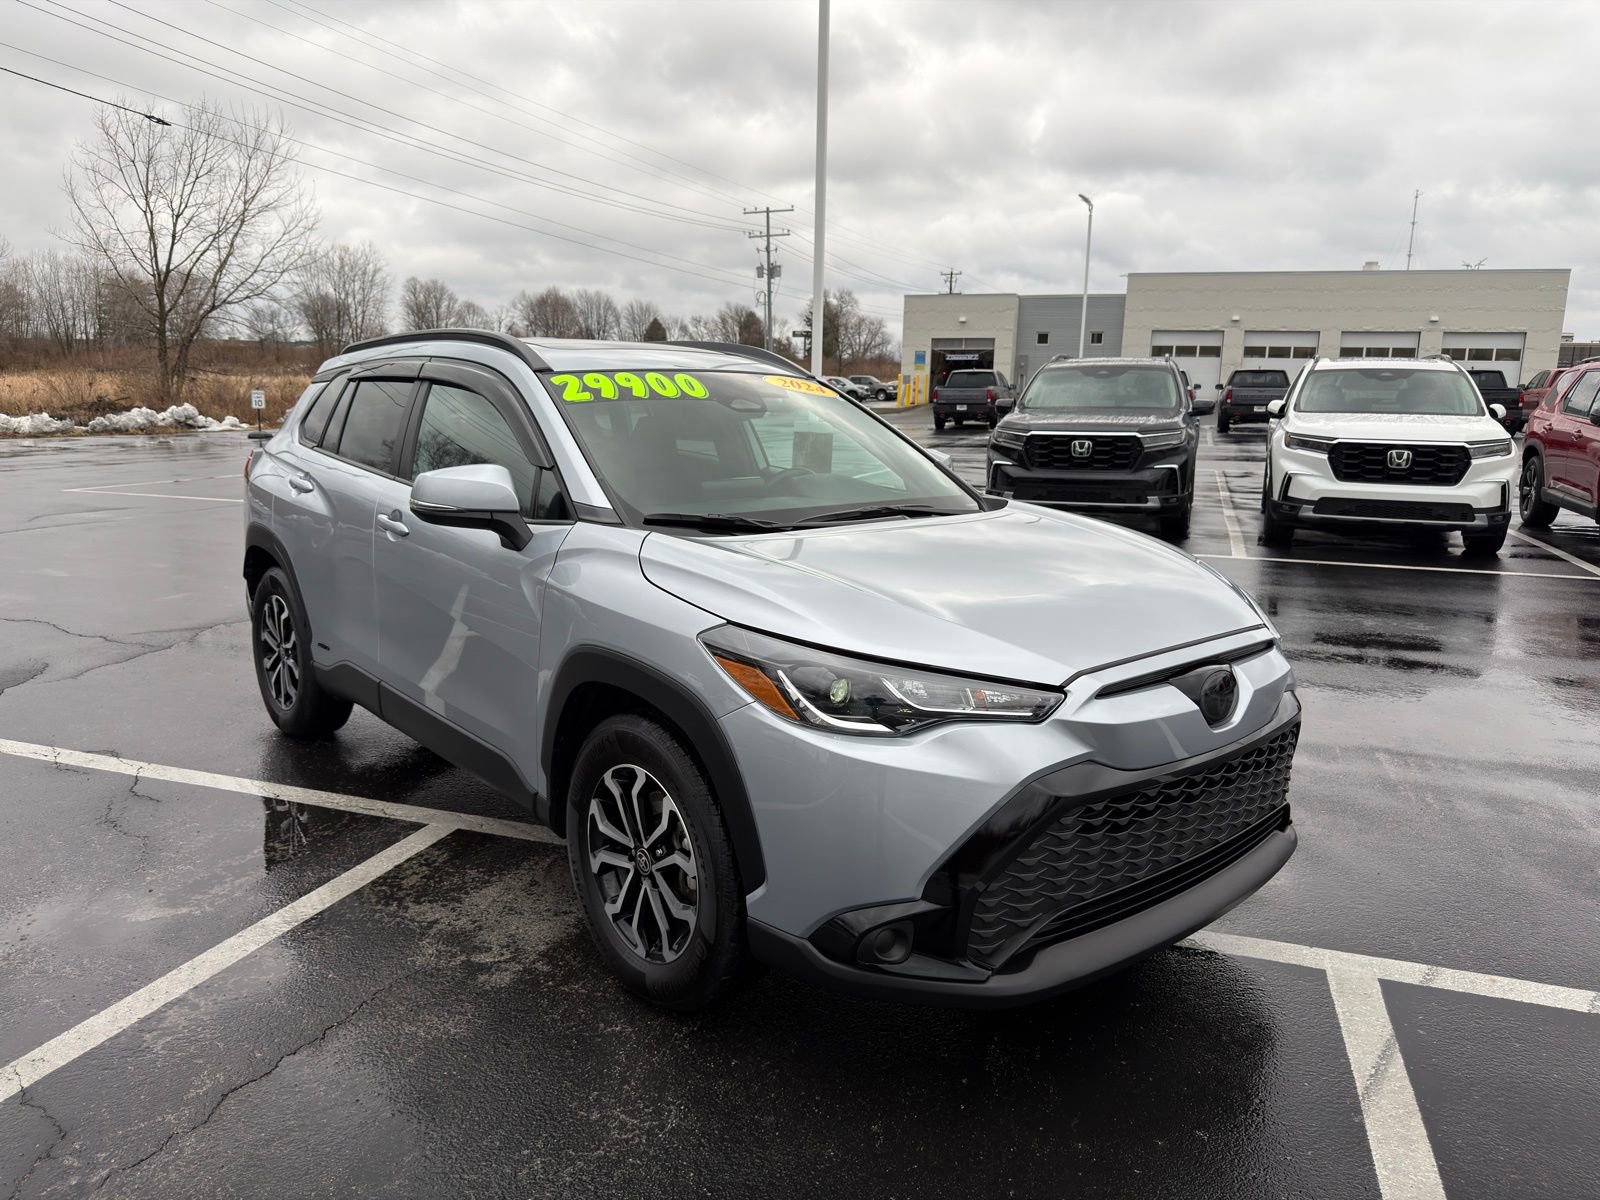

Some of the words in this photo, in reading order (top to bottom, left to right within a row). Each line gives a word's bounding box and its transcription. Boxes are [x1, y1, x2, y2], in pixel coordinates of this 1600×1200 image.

[551, 372, 709, 401] 29900
[777, 379, 827, 394] 2024
[254, 399, 263, 407] 10
